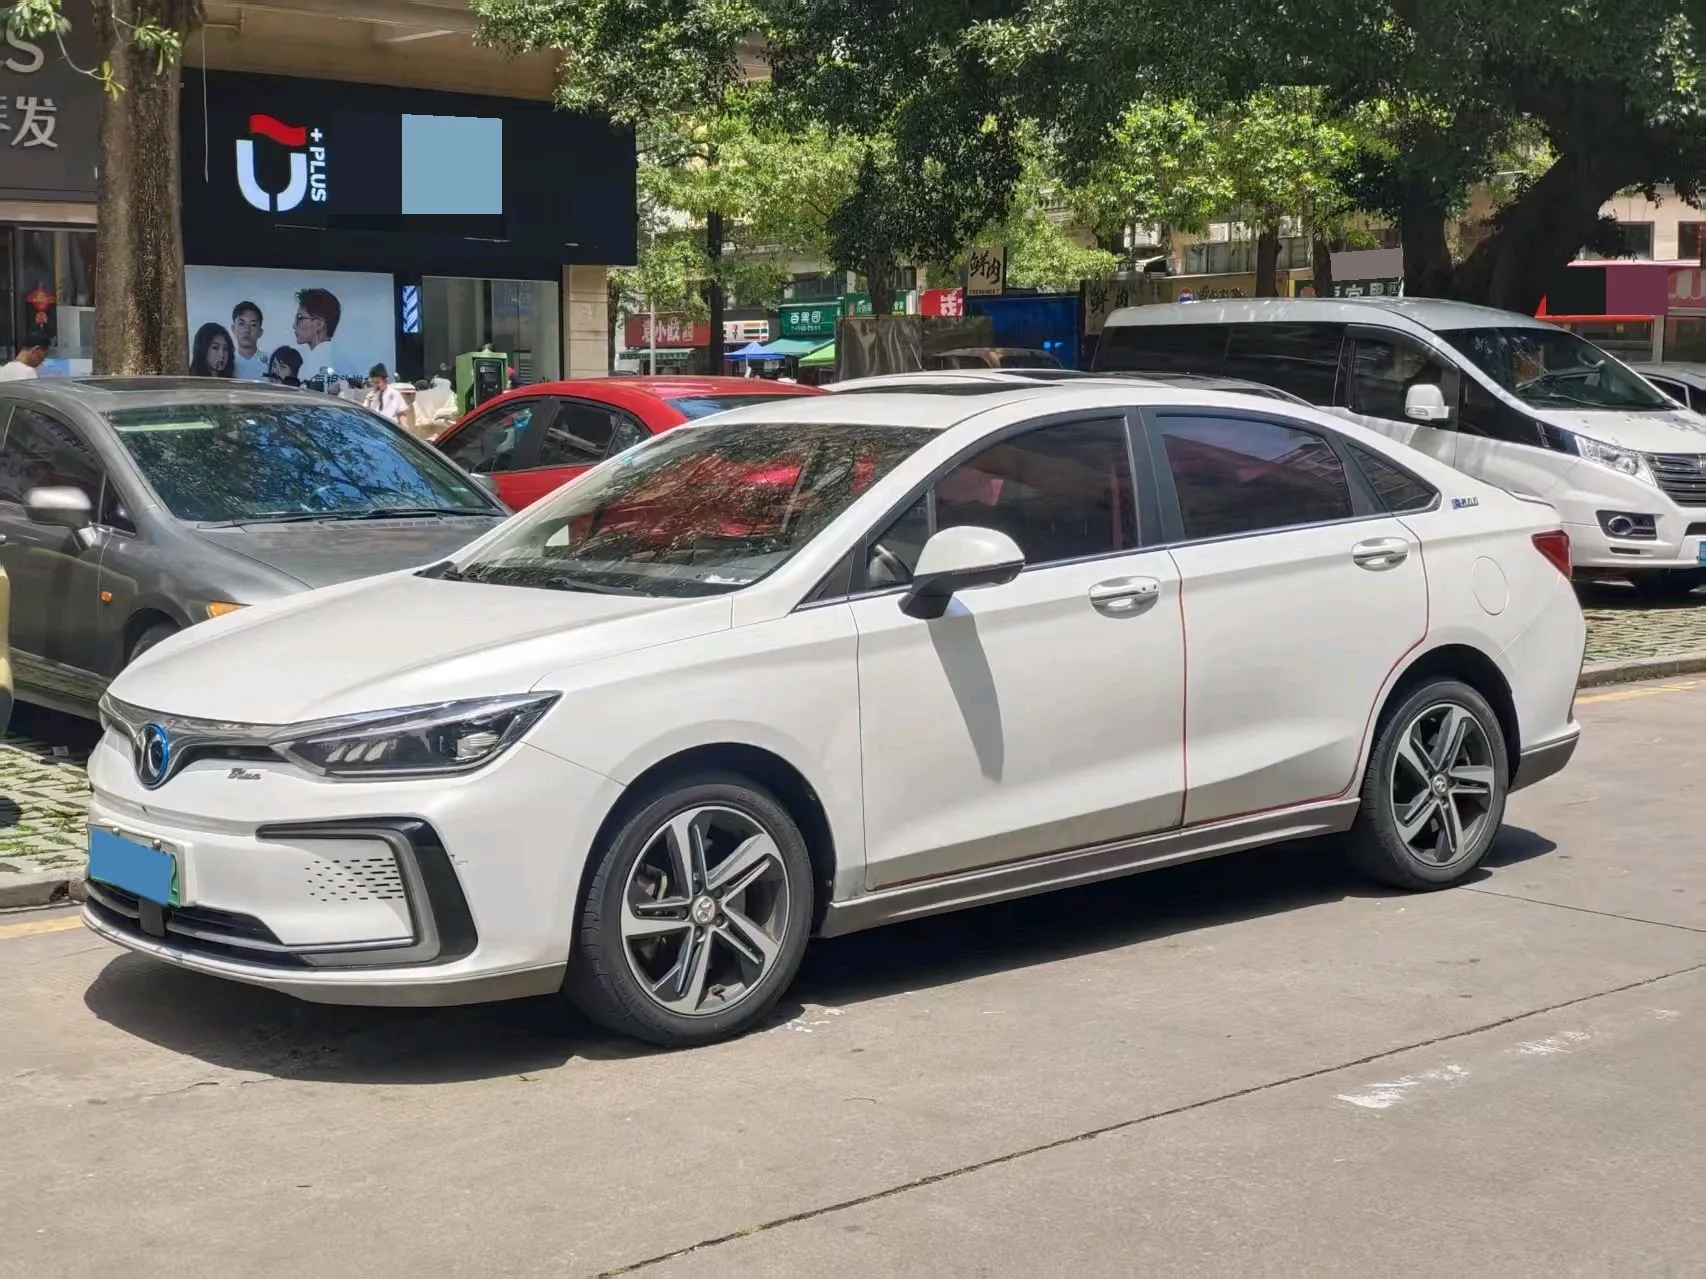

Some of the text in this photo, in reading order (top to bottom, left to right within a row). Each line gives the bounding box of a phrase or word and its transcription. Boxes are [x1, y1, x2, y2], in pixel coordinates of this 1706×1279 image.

[970, 250, 1001, 284] 鲜肉
[790, 311, 821, 324] 百果园
